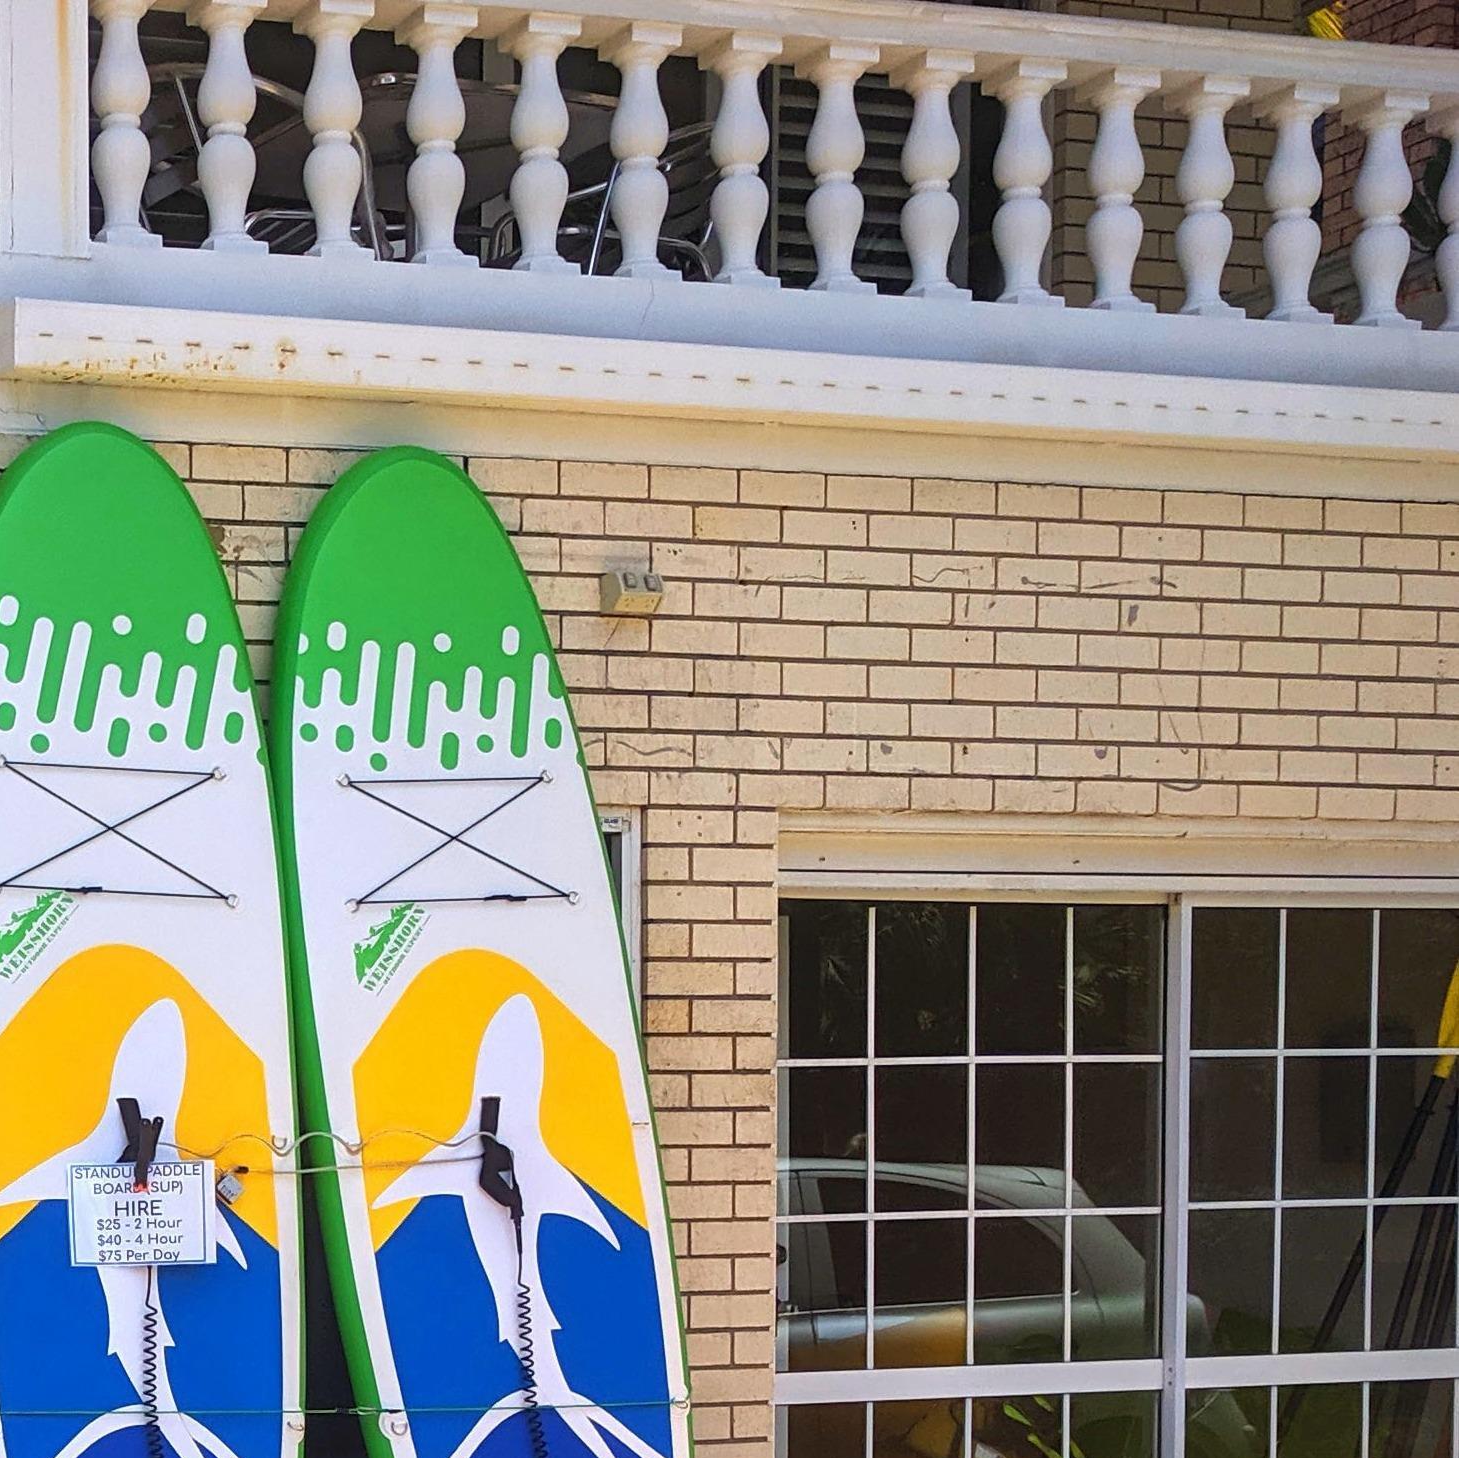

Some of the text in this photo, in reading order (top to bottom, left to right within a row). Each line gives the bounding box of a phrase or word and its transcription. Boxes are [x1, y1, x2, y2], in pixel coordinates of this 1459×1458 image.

[0, 893, 76, 979] WEISSHORN
[364, 905, 426, 991] WEISSHORN
[115, 1200, 162, 1217] HIRE
[97, 1218, 182, 1230] $25 2 Hour
[98, 1233, 183, 1246] $40 4 Hour
[99, 1249, 180, 1262] $75 Per Day
